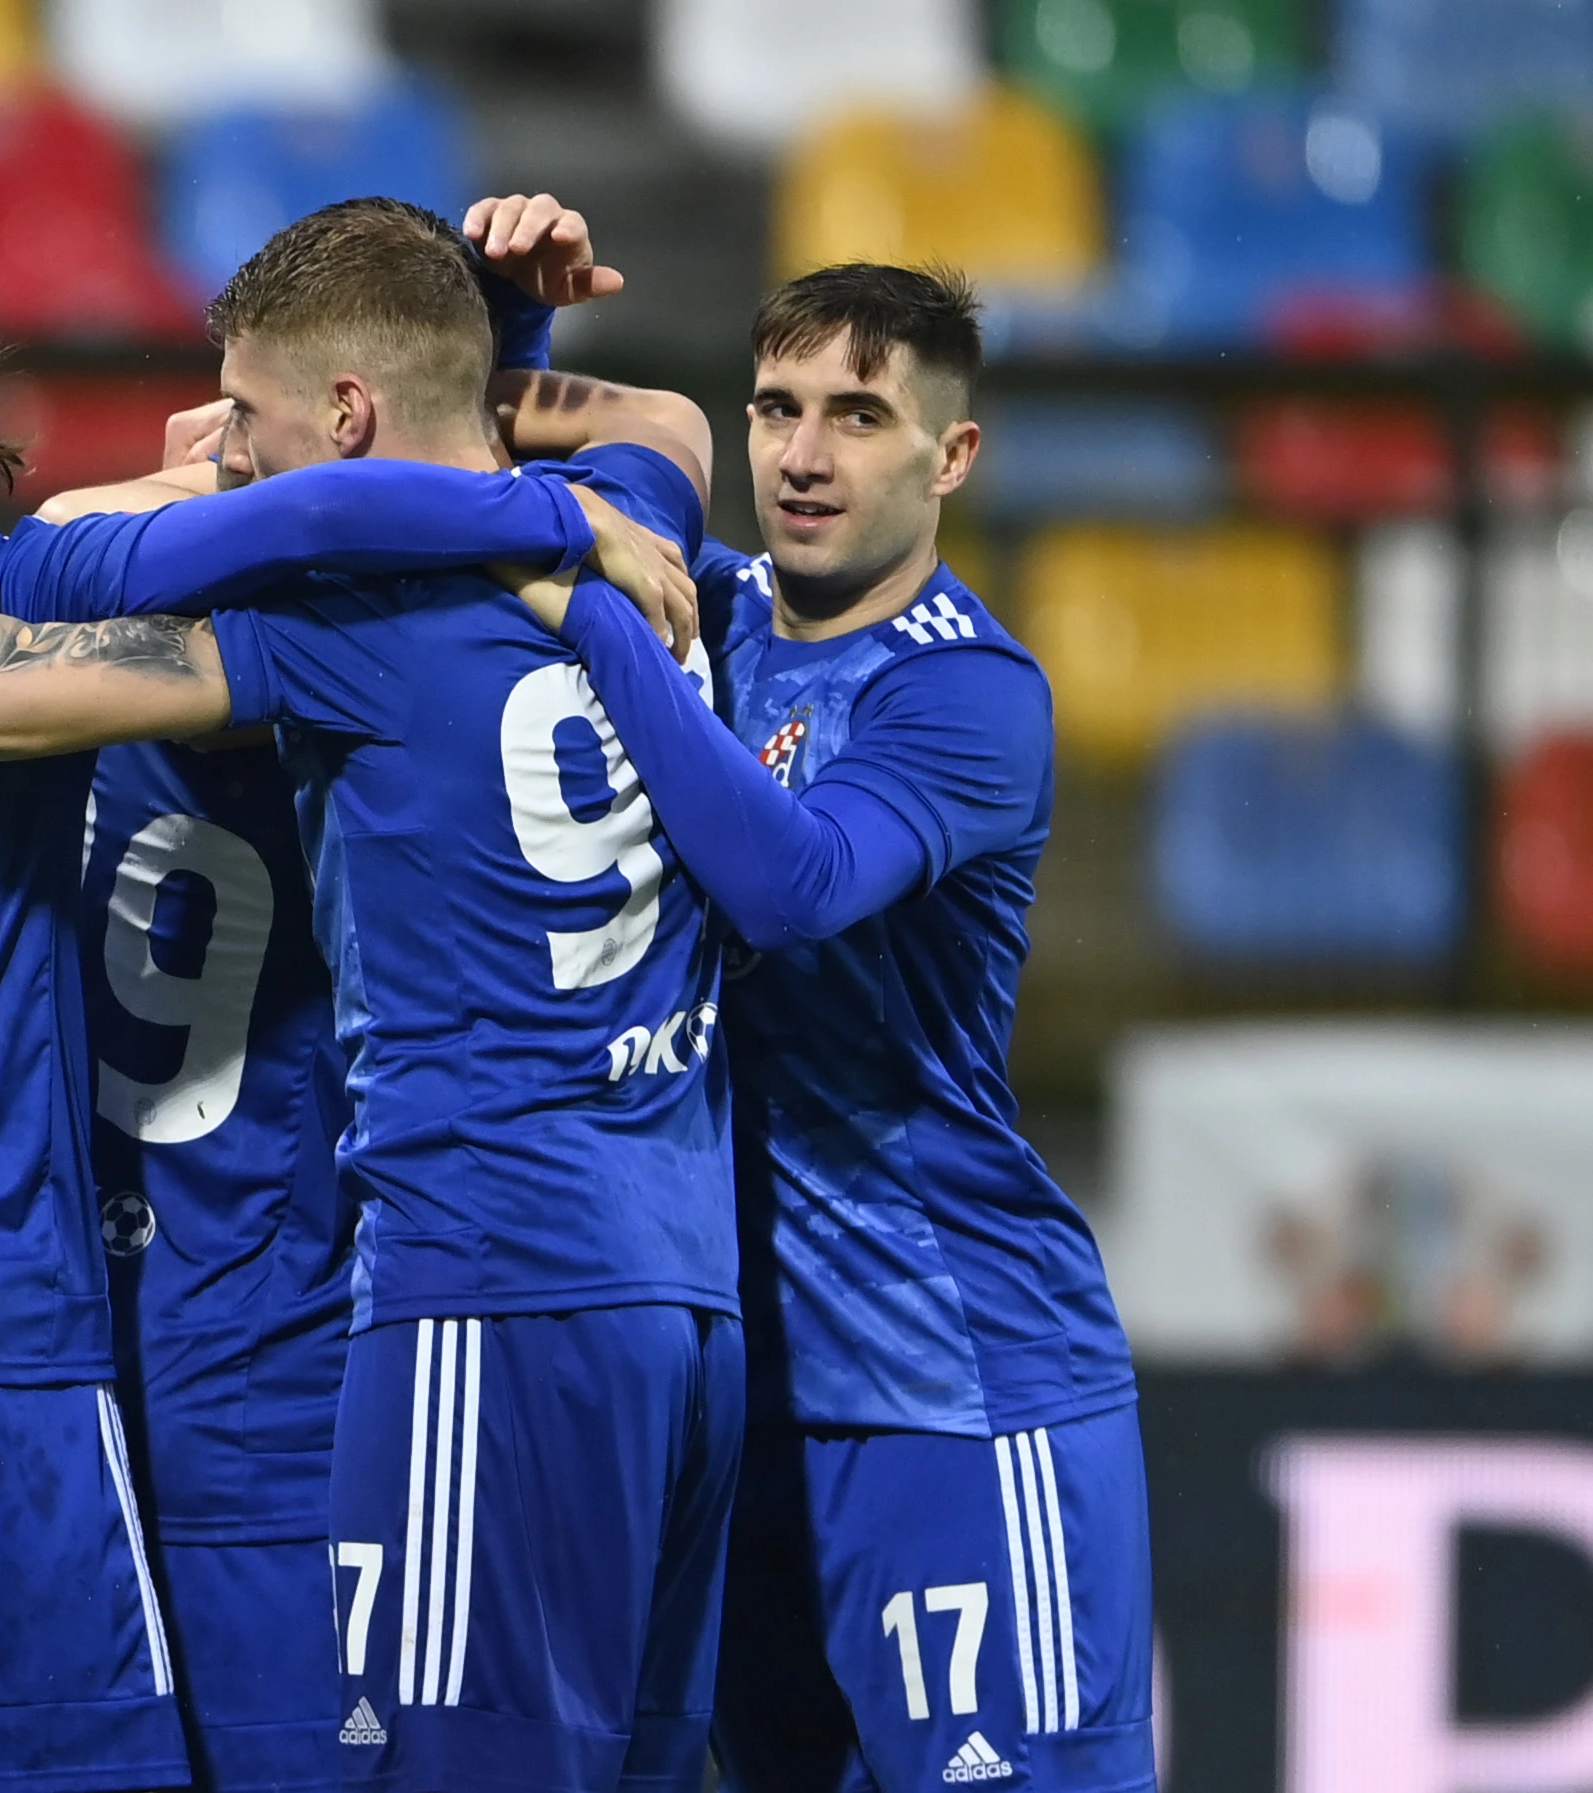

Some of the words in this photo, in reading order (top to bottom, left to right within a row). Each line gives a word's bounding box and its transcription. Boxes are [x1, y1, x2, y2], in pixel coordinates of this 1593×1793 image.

[500, 632, 715, 990] 9
[82, 788, 274, 1144] 9
[329, 1541, 384, 1676] 7
[881, 1581, 989, 1720] 17
[339, 1727, 388, 1745] adidas
[942, 1760, 1013, 1783] adidas
